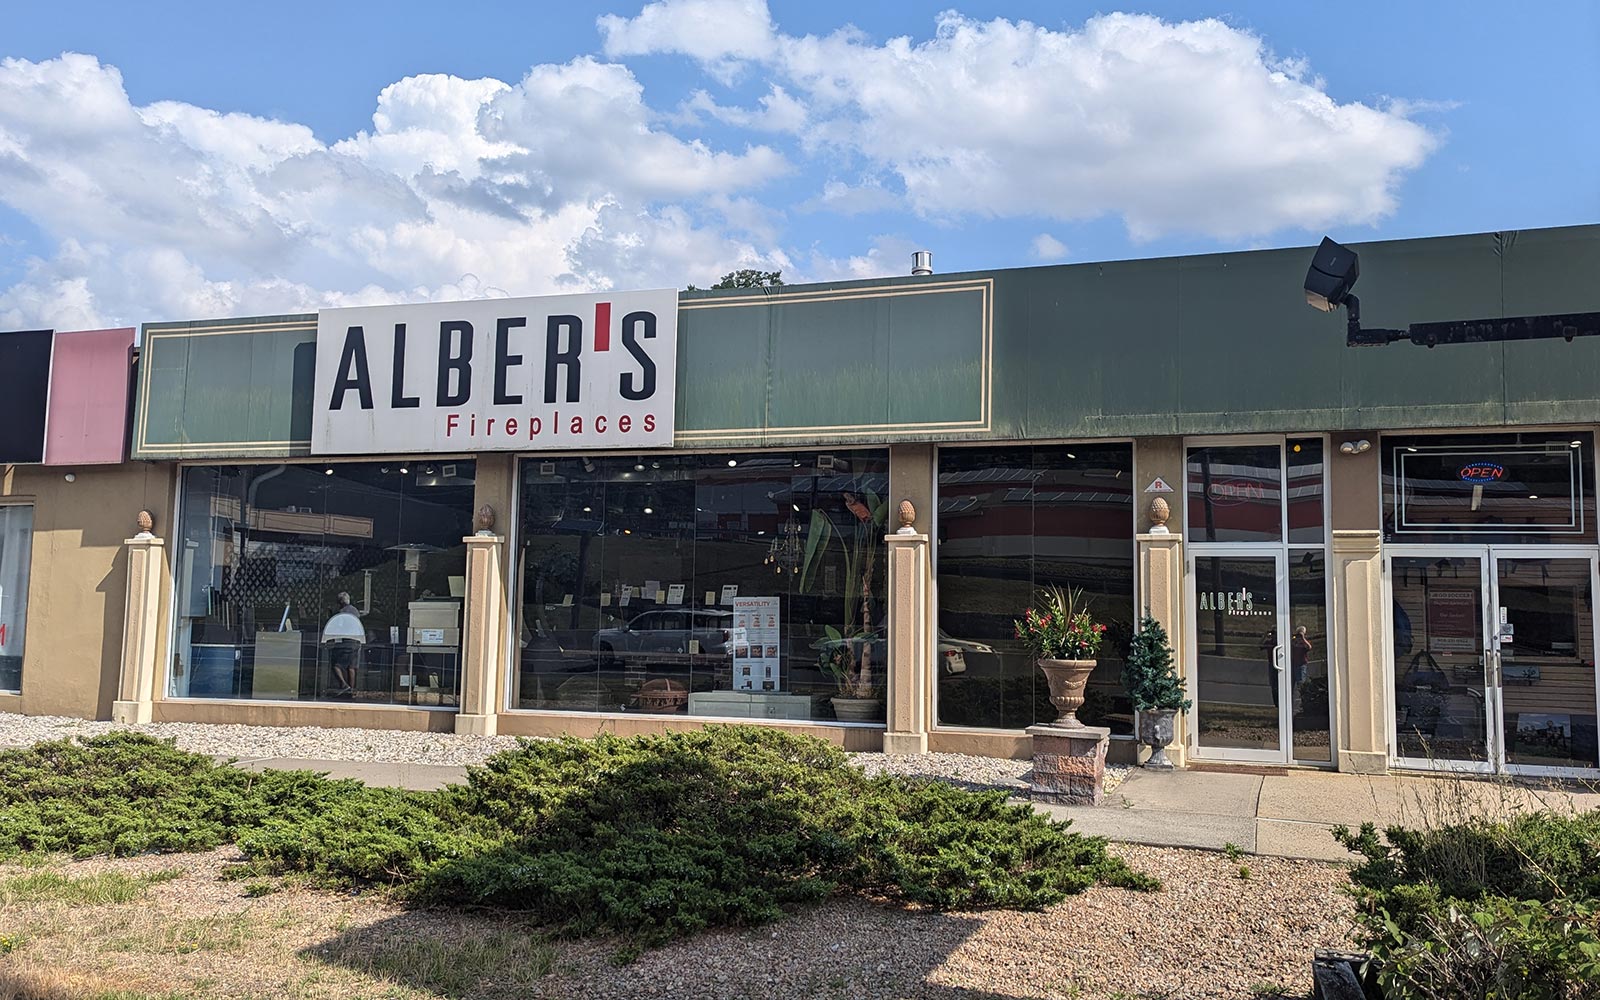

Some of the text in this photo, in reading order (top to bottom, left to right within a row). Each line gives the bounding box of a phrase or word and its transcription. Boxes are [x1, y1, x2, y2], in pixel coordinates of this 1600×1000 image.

[329, 302, 657, 411] ALBER'S
[446, 411, 656, 440] Fireplaces
[1460, 467, 1504, 478] OPEN
[1207, 483, 1265, 500] OPEN
[1200, 587, 1253, 610] ALBER'S
